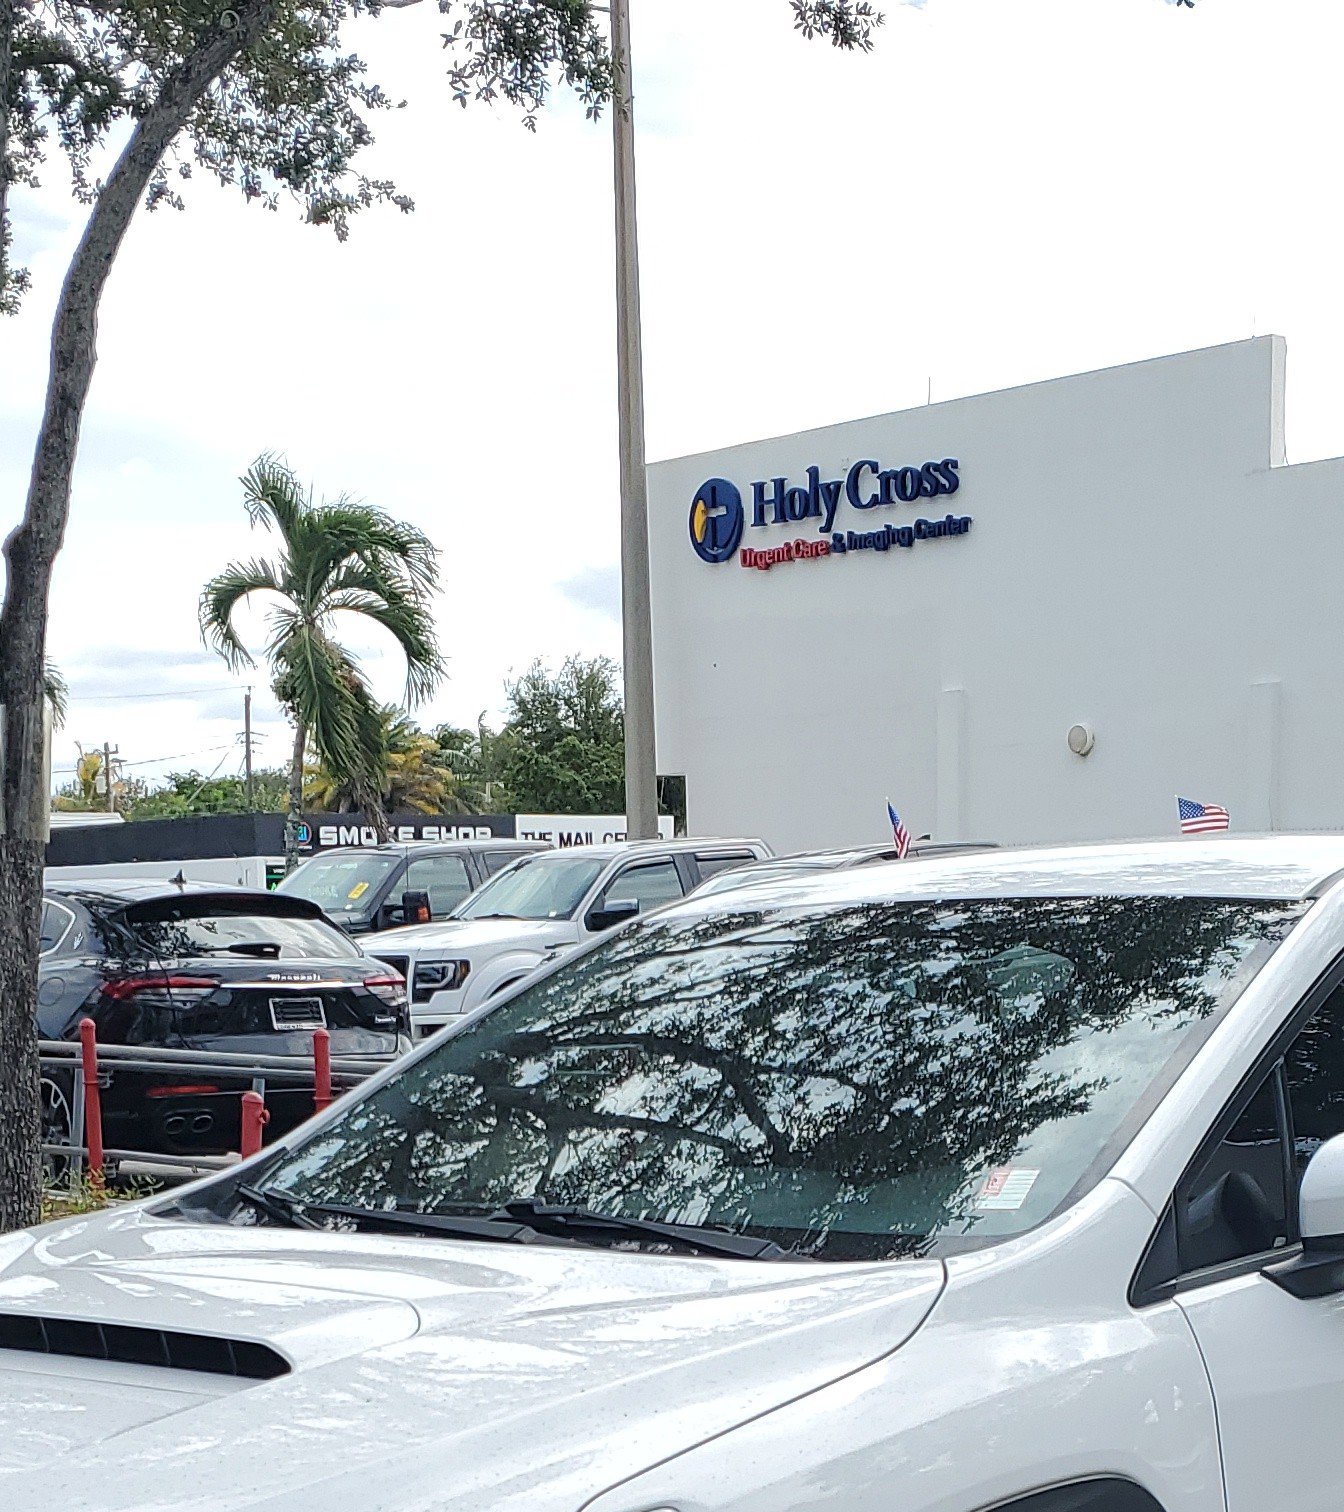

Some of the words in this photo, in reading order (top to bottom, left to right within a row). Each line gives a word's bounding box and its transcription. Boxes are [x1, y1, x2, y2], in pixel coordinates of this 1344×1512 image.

[750, 466, 844, 533] Holy
[846, 459, 959, 510] Cross
[739, 541, 792, 570] Urgent
[792, 538, 830, 558] Care
[830, 532, 846, 553] &
[846, 524, 914, 551] Imaging
[913, 514, 973, 540] Center
